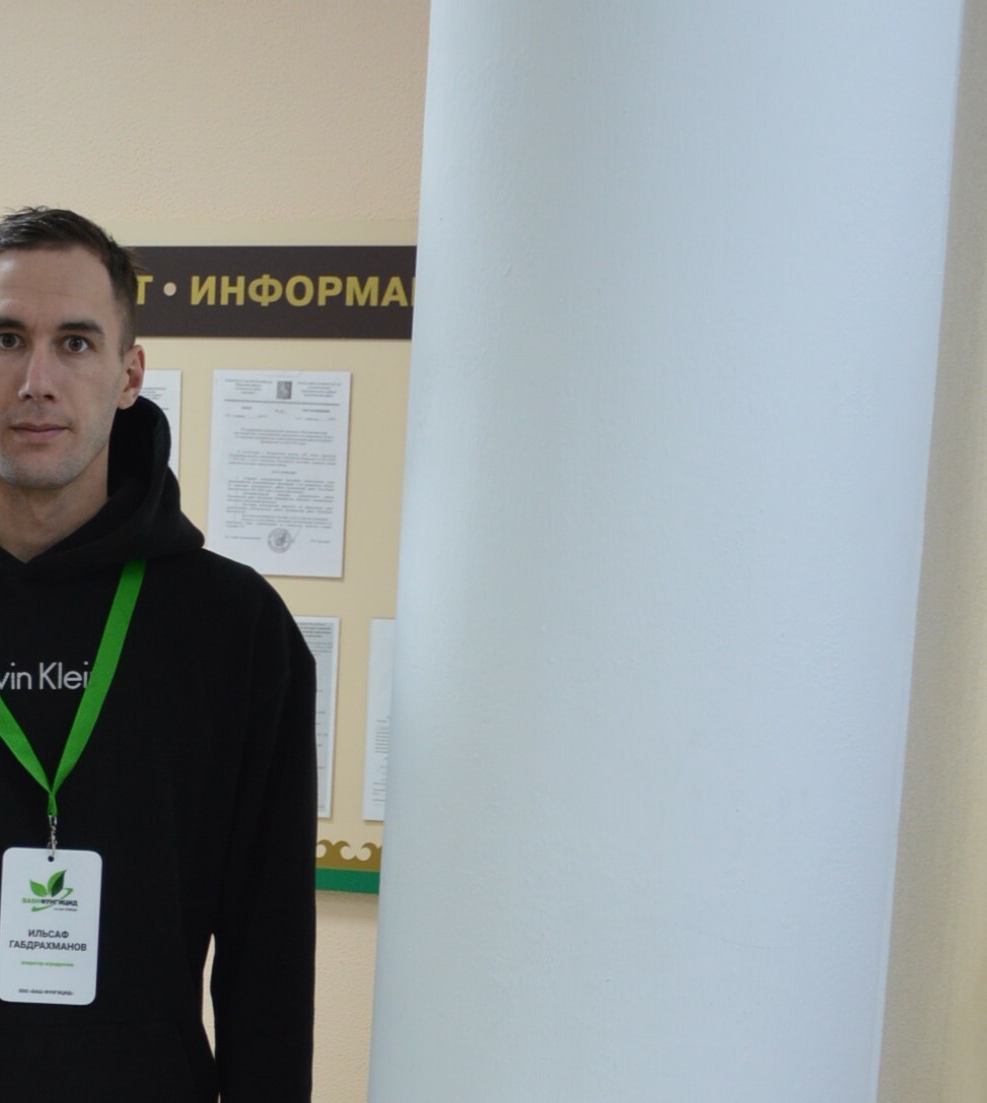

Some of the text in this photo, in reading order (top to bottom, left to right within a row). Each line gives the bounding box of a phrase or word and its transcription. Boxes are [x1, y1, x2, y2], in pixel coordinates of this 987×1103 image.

[191, 275, 414, 306] ИНФОРМА
[39, 661, 92, 690] Klei
[28, 929, 70, 939] ИЛЬСАФ
[9, 940, 87, 951] ГАБДРАХМАНОВ
